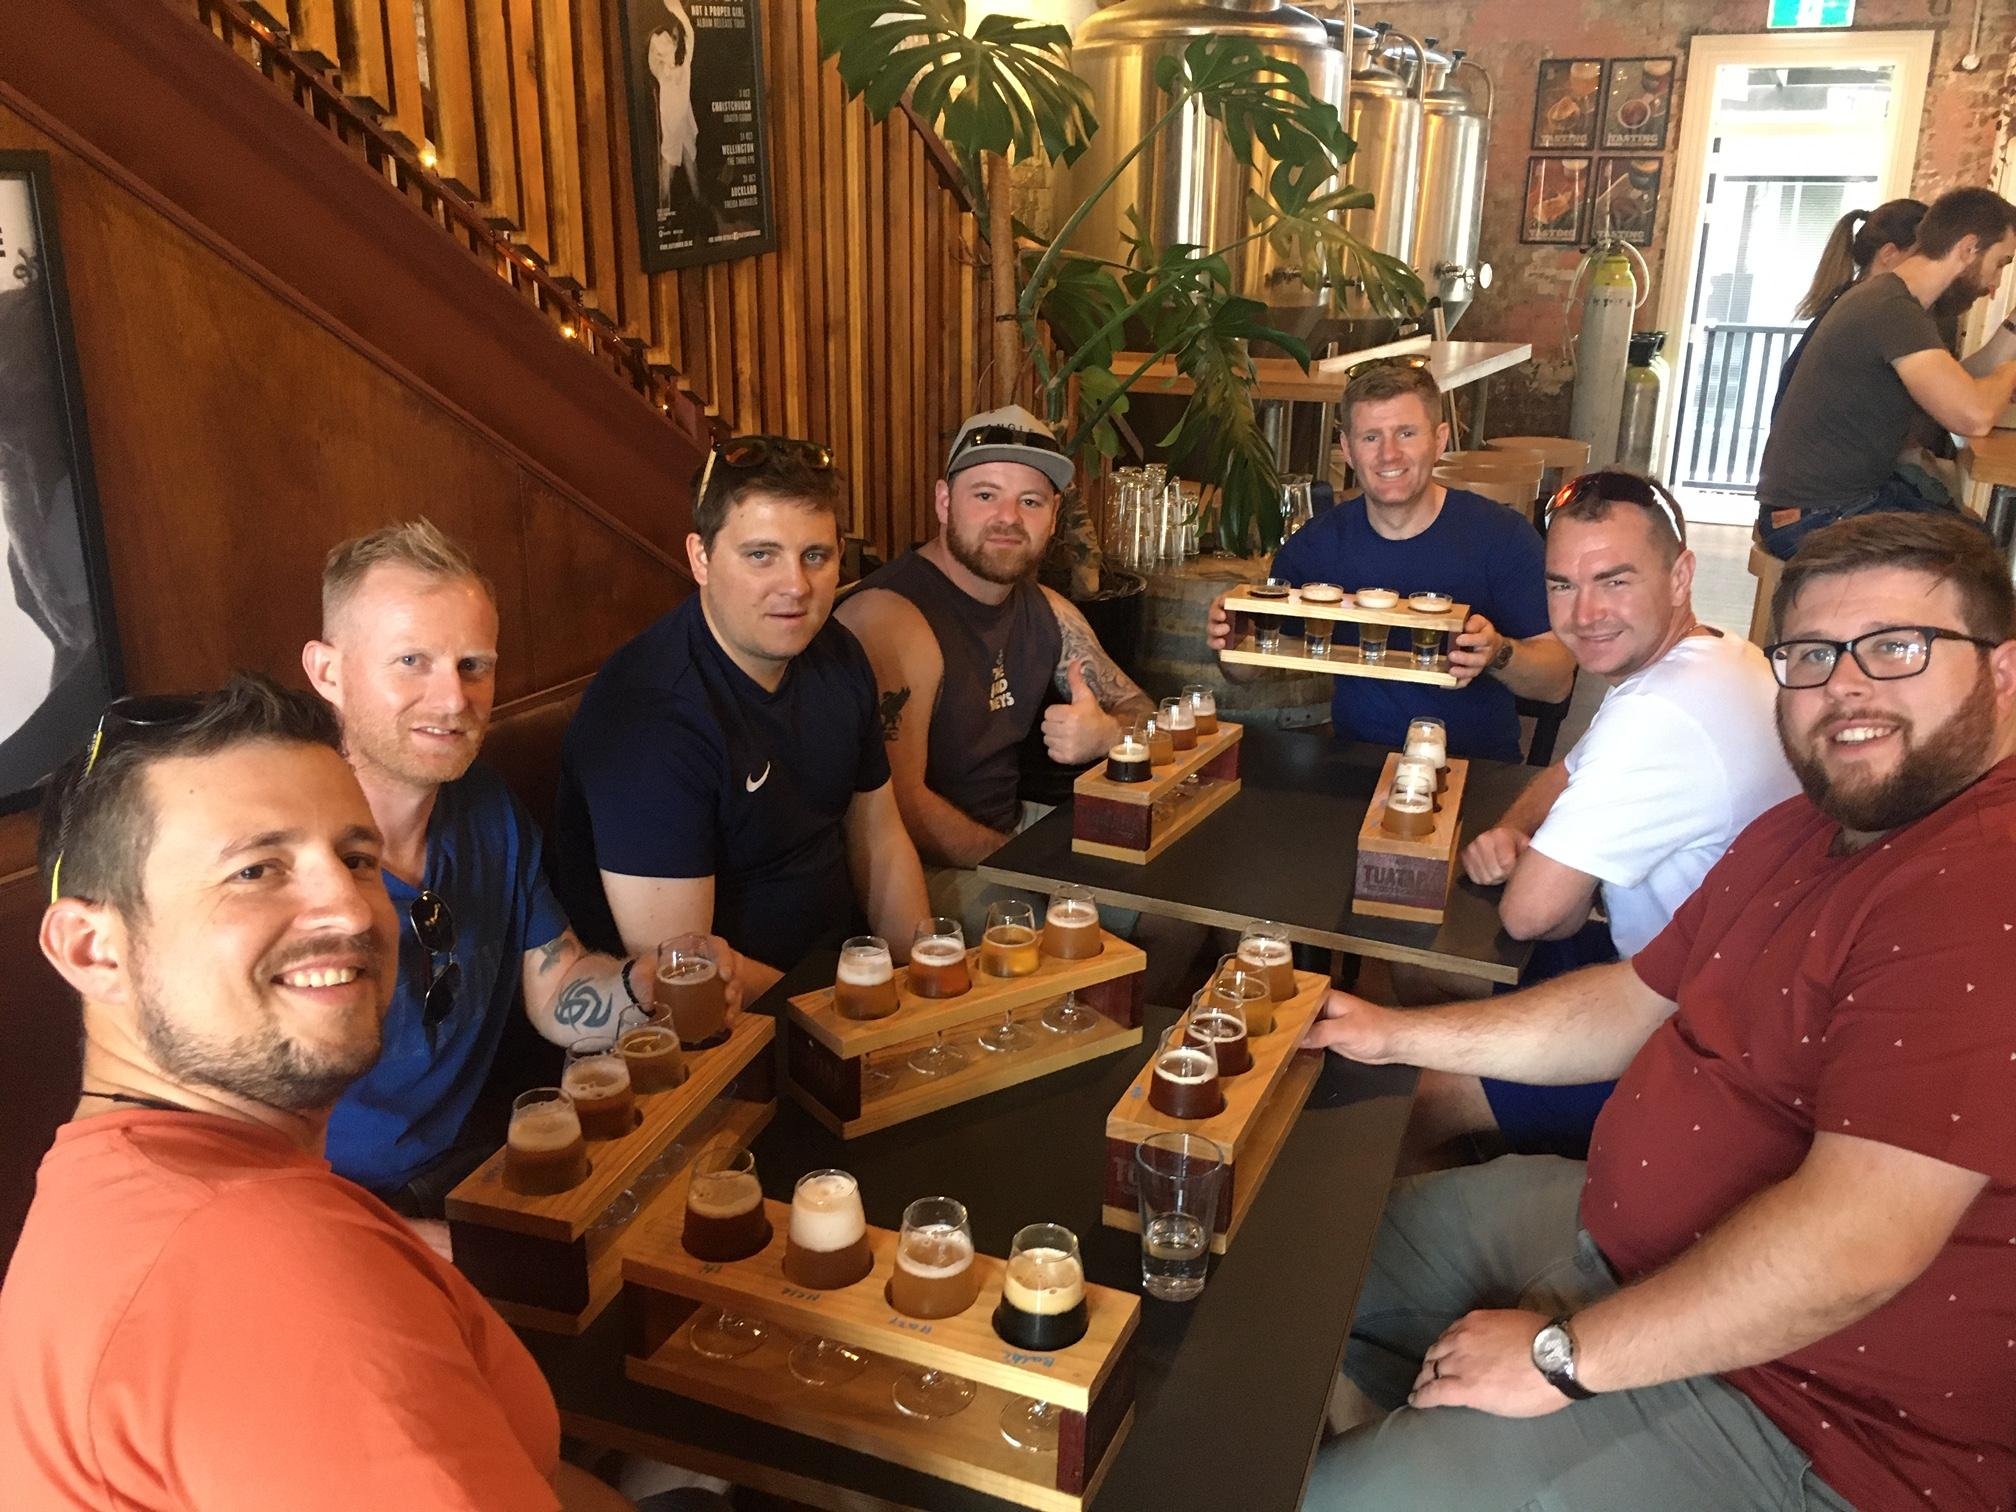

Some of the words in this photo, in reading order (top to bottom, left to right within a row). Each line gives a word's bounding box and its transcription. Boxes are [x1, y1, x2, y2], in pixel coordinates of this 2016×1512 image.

[711, 100, 752, 112] CHRISTCHURCH
[721, 143, 755, 155] WELLINGTON
[731, 185, 757, 197] AUCKLAND
